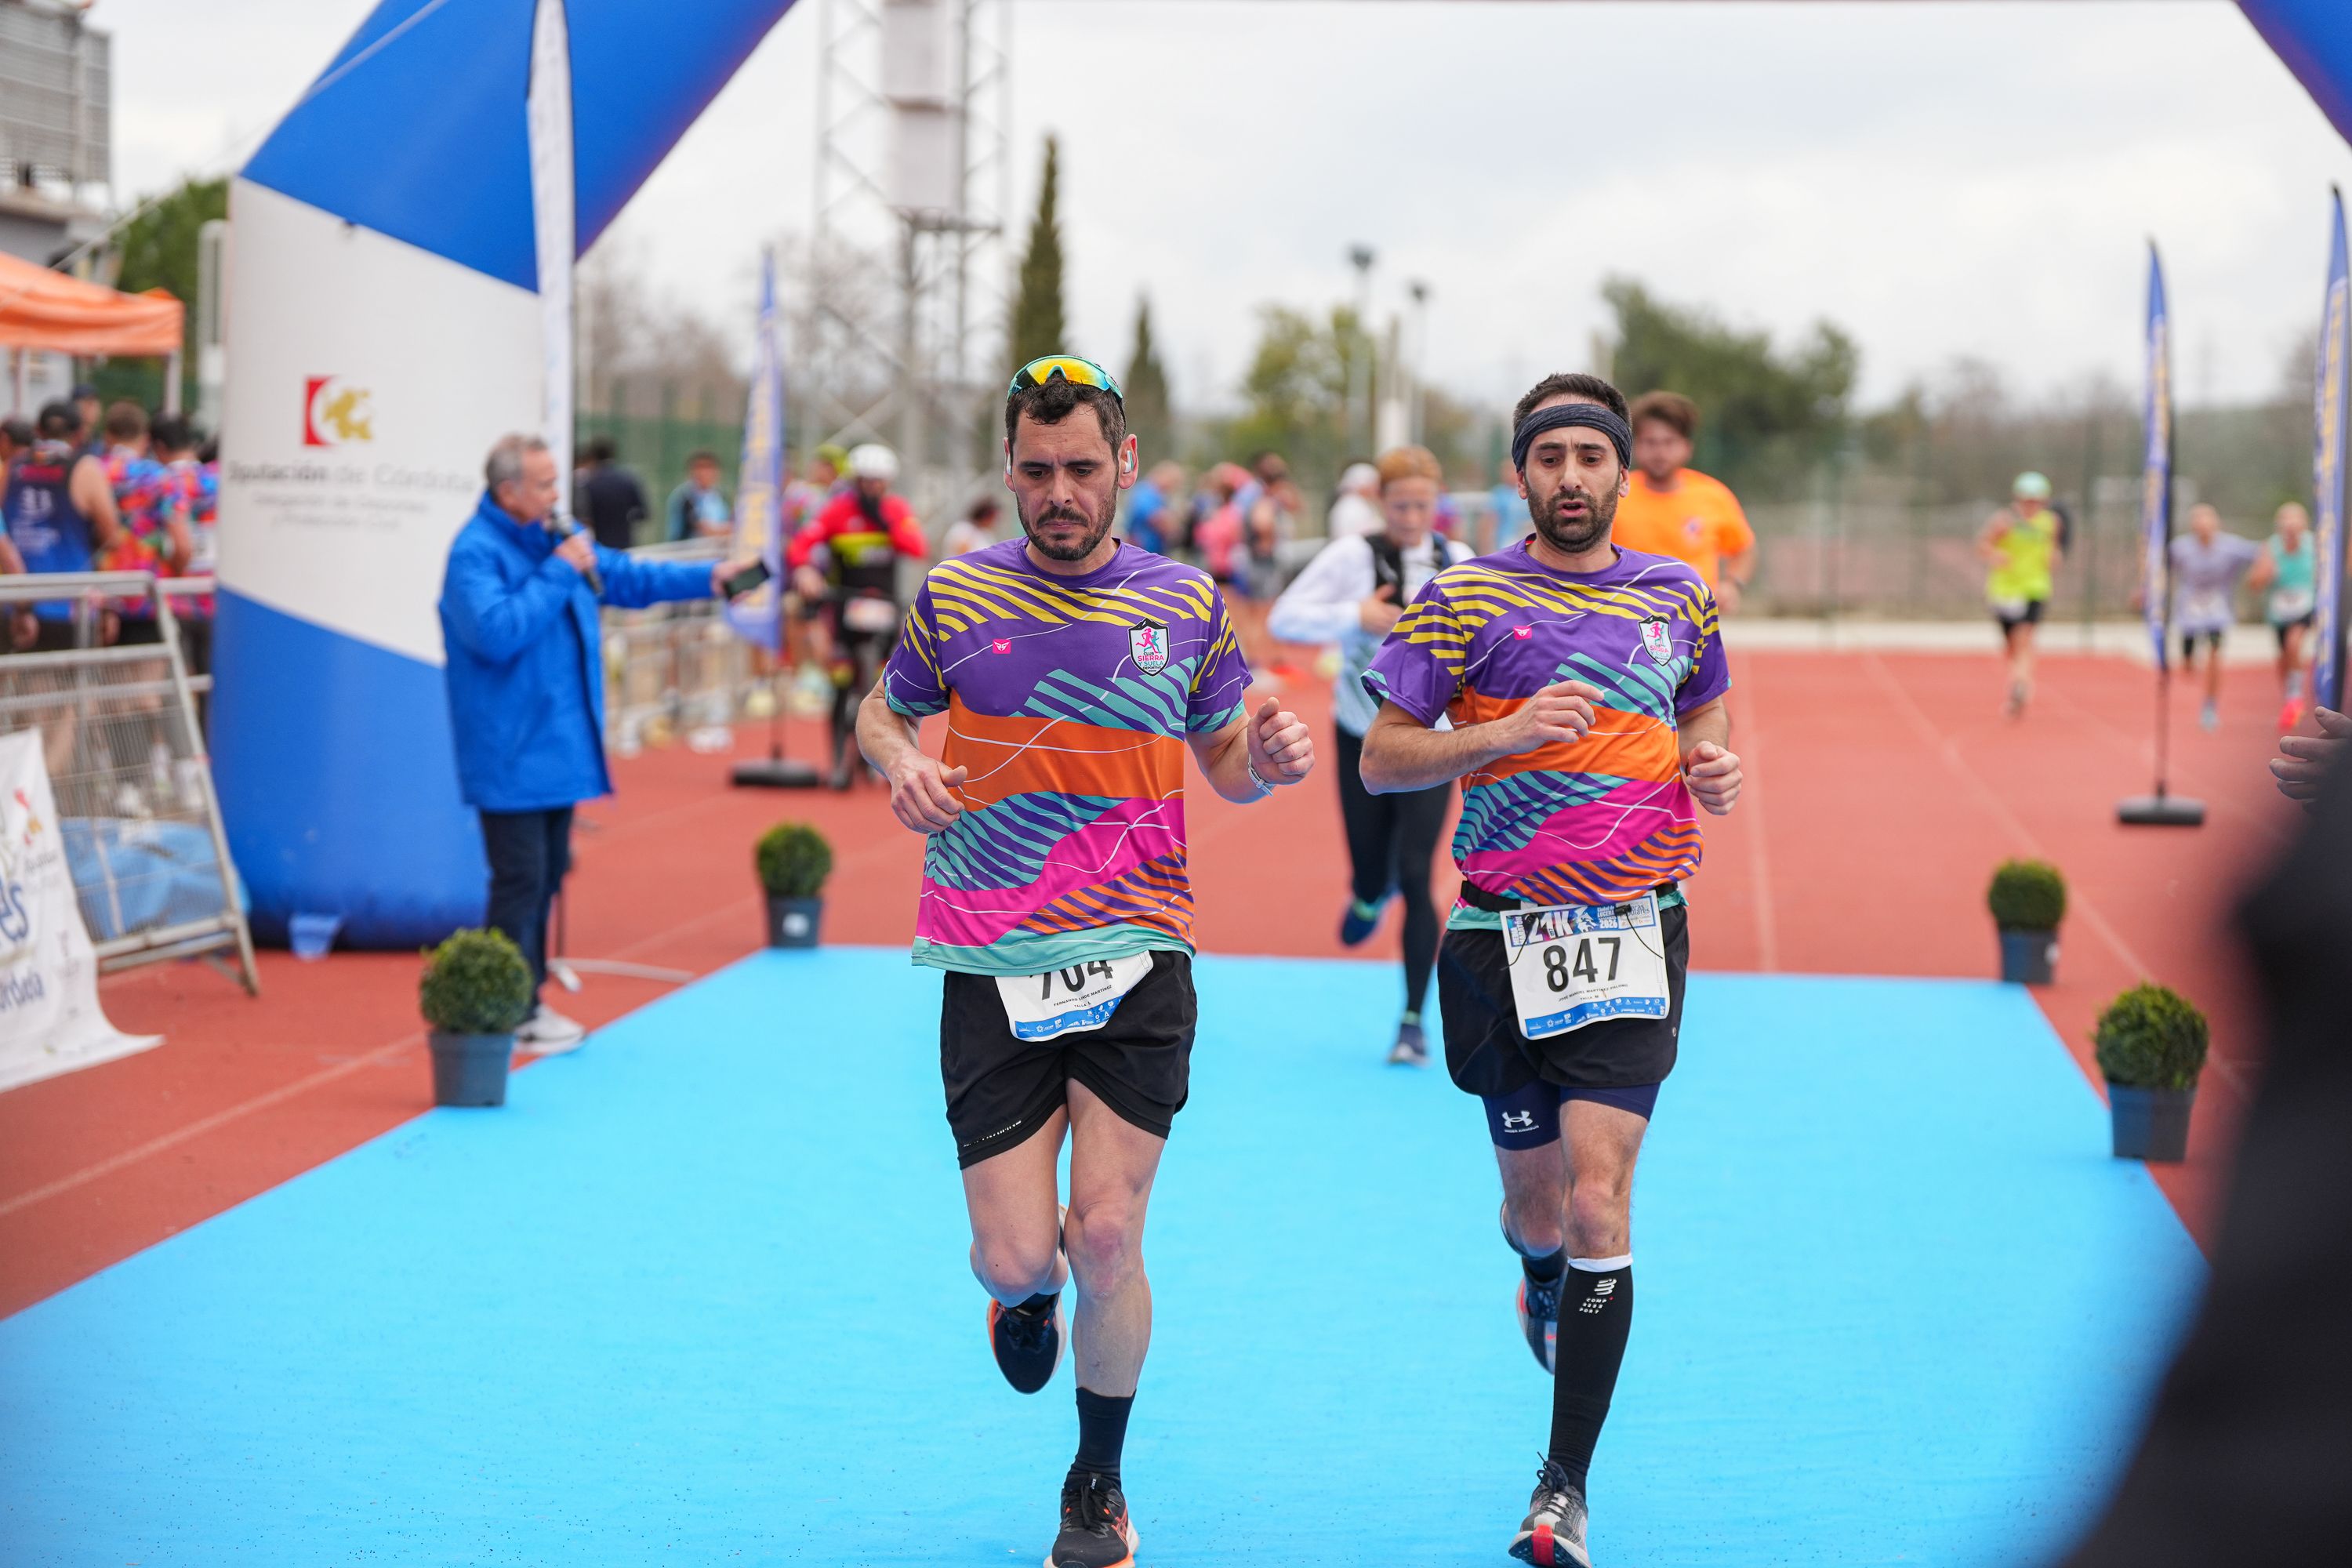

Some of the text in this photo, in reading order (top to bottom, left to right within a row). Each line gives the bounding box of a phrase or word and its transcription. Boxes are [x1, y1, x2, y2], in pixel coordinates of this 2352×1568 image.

[1599, 919, 1618, 929] 2026
[1544, 937, 1621, 992] 847
[1054, 998, 1078, 1007] FERNANDO
